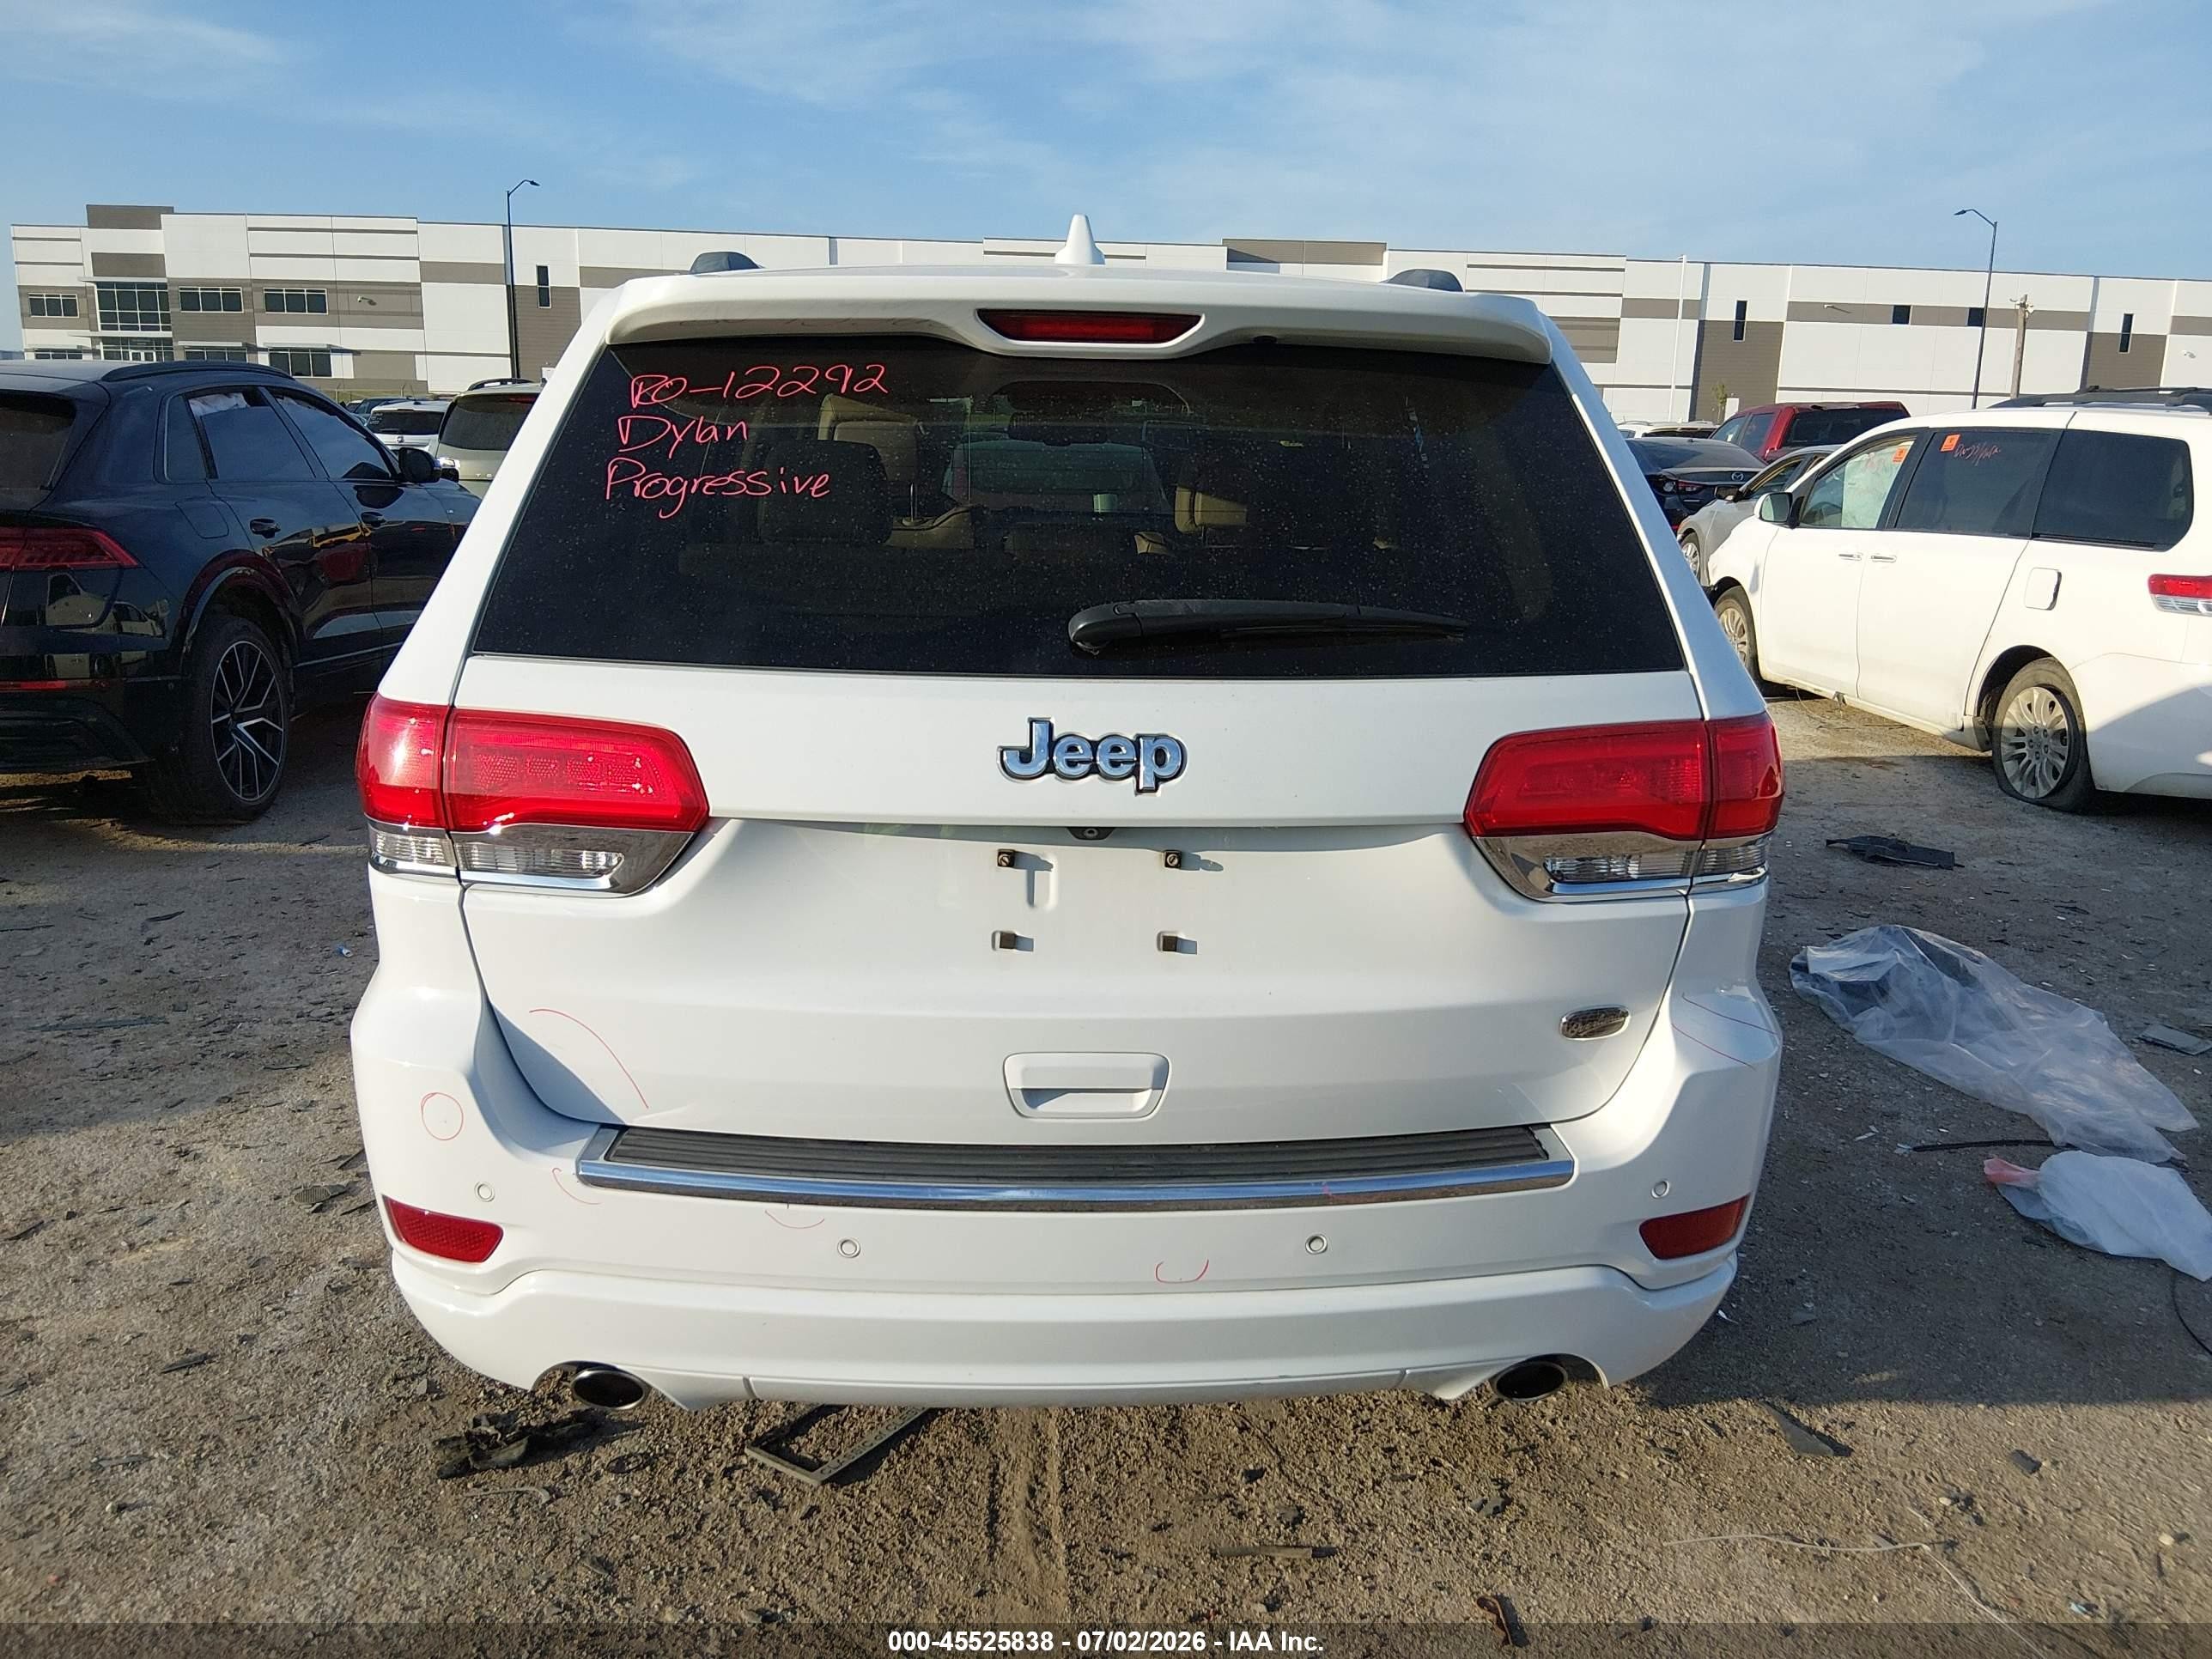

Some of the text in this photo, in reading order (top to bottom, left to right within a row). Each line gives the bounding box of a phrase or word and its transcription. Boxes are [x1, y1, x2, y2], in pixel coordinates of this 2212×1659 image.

[617, 416, 748, 459] Dylan
[605, 458, 830, 519] Progressive
[998, 717, 1188, 793] Jeep
